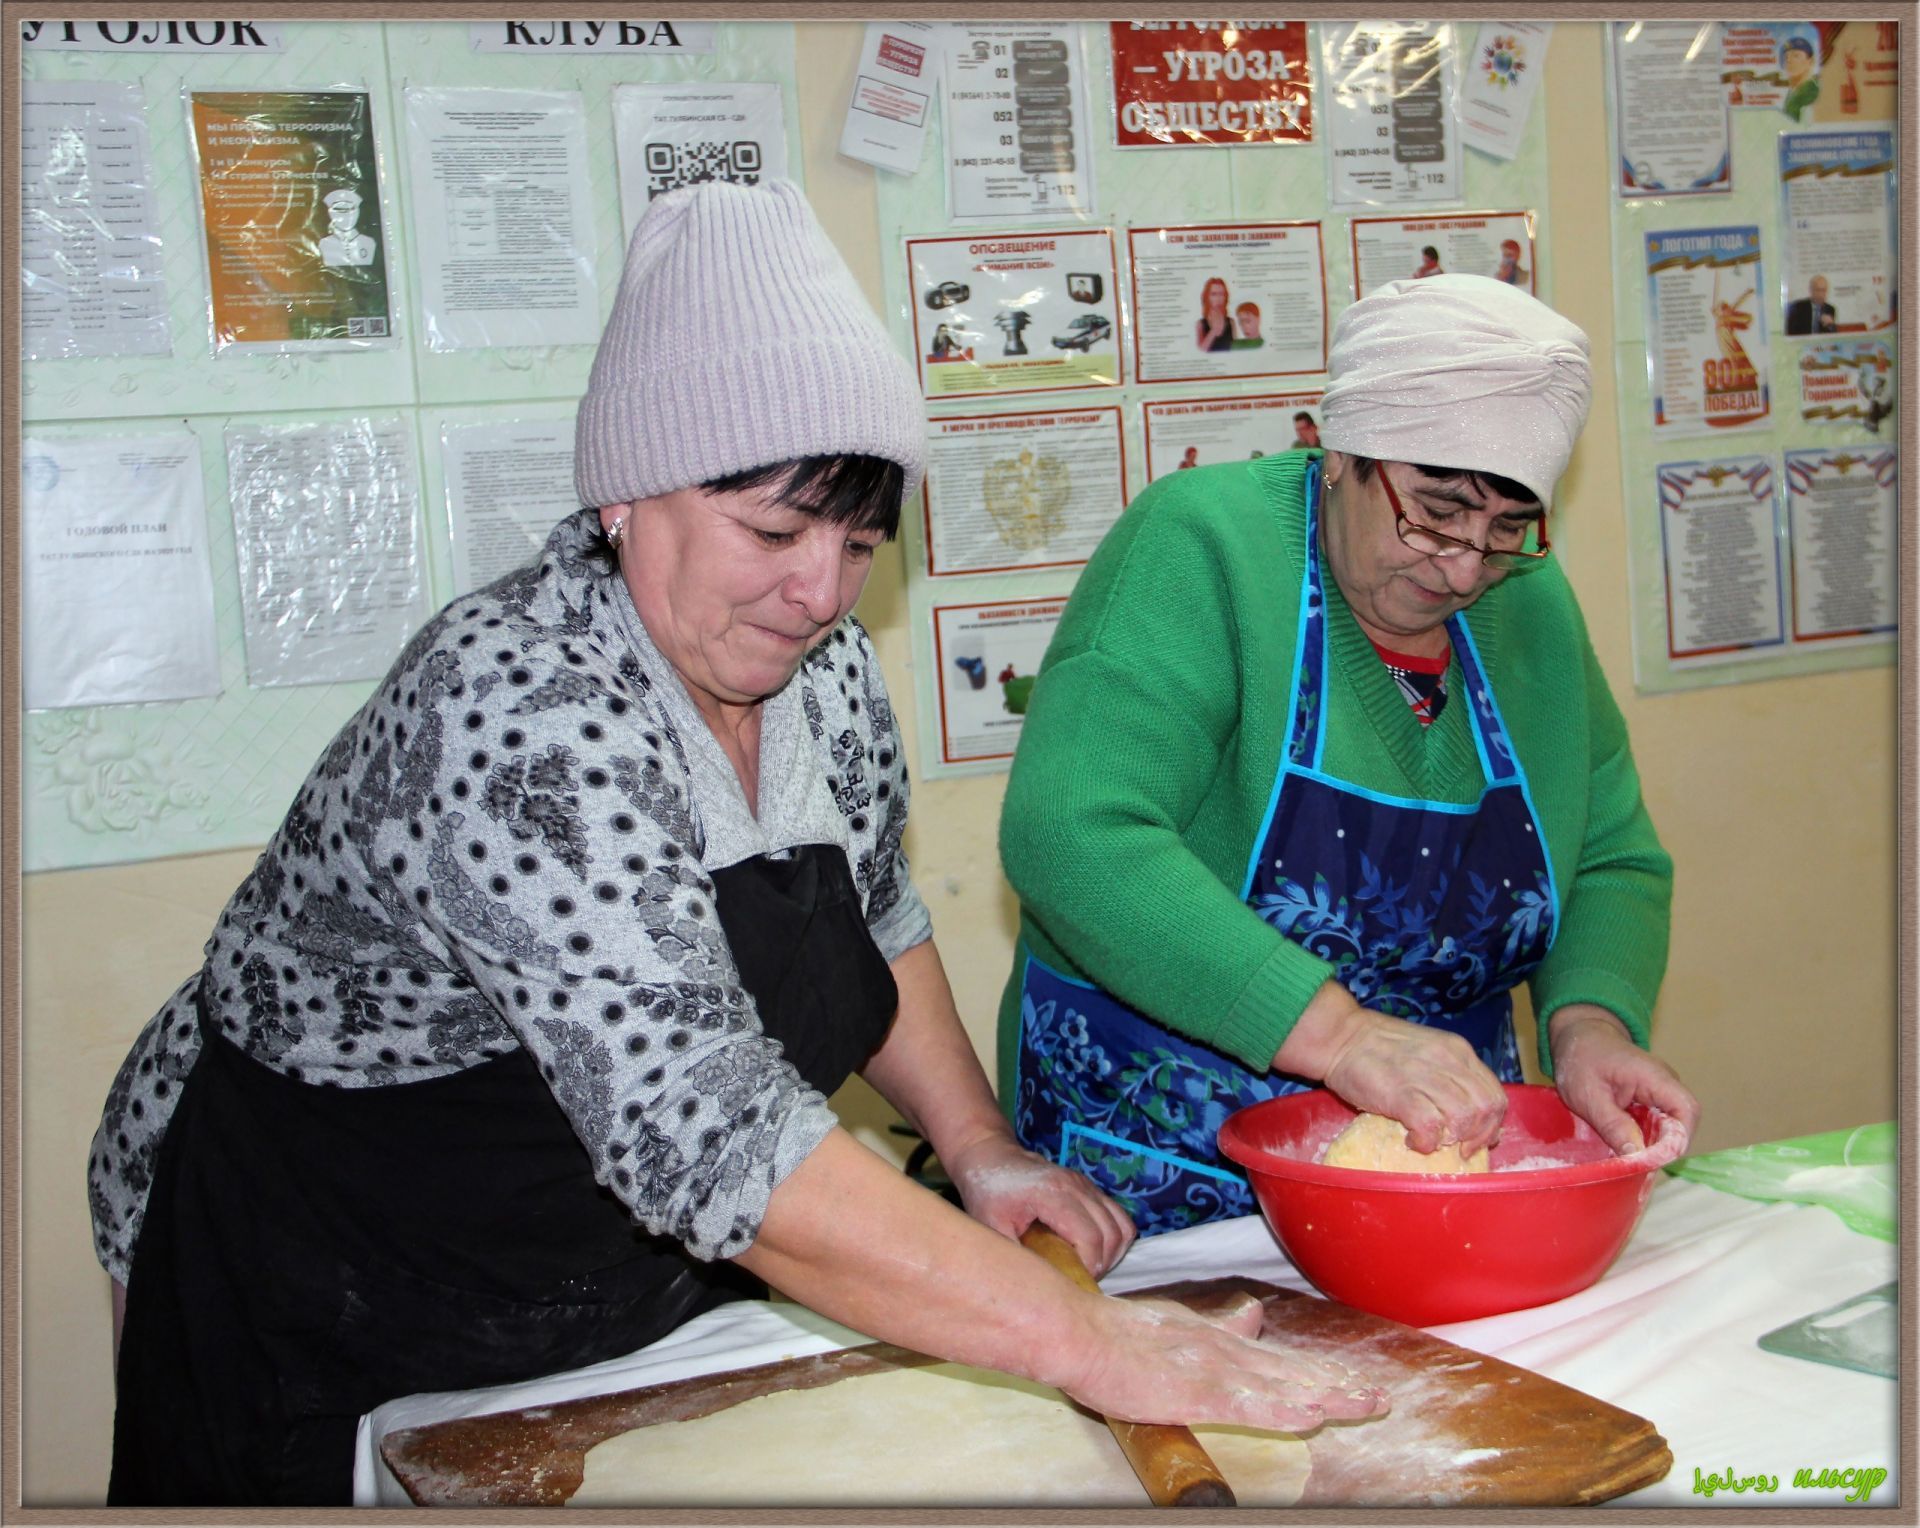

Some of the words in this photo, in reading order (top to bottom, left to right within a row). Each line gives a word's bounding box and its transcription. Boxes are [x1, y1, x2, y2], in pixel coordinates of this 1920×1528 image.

[1162, 49, 1291, 82] УГРОЗА
[995, 68, 1009, 79] 02
[993, 111, 1013, 123] 052
[1121, 100, 1303, 133] ОБЩЕСТВУ
[207, 122, 227, 132] МЫ
[278, 122, 355, 132] ТЕРРОРИЗМА
[1376, 126, 1389, 137] 03
[1000, 135, 1013, 146] 03
[1427, 174, 1445, 184] 112
[969, 241, 1056, 254] ОПОВЕЩЕНИЕ
[1662, 236, 1711, 253] ЛОГОТИП
[1713, 233, 1744, 250] ГОДА
[1803, 374, 1848, 387] Помним!
[1803, 387, 1857, 402] Гордимся!
[1704, 392, 1759, 412] ПОБЕДА!
[66, 523, 128, 537] ГОДОВОЙ
[131, 523, 168, 534] ПЛАН
